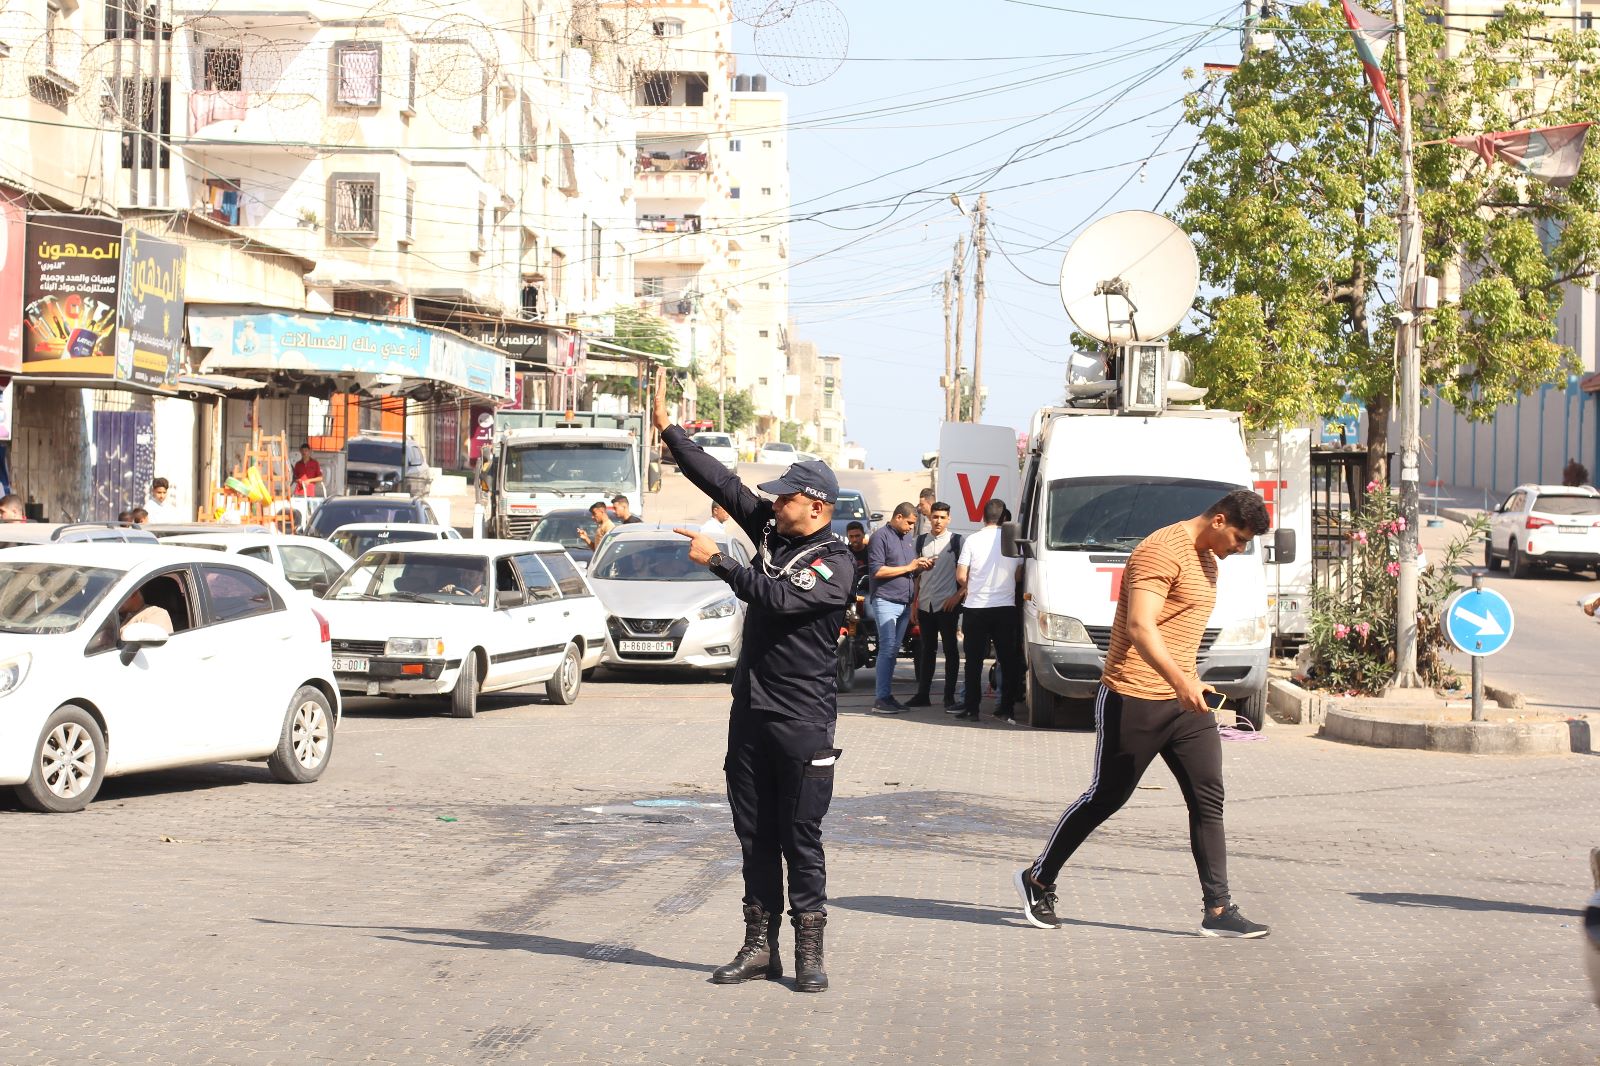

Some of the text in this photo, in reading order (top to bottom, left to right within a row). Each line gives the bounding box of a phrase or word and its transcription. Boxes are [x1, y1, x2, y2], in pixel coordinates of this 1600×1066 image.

[38, 241, 120, 260] المدهون
[66, 274, 90, 283] والعدد
[131, 249, 179, 304] المدهون
[57, 283, 76, 292] مواد
[76, 284, 116, 293] مستلزمات
[279, 331, 348, 350] الغسالات
[351, 336, 378, 353] ملك
[499, 334, 542, 347] العالمي
[380, 343, 406, 360] عدي
[805, 486, 828, 500] POLICE
[956, 472, 1001, 522] V
[1254, 480, 1287, 528] T
[622, 641, 665, 651] 3-8608-05
